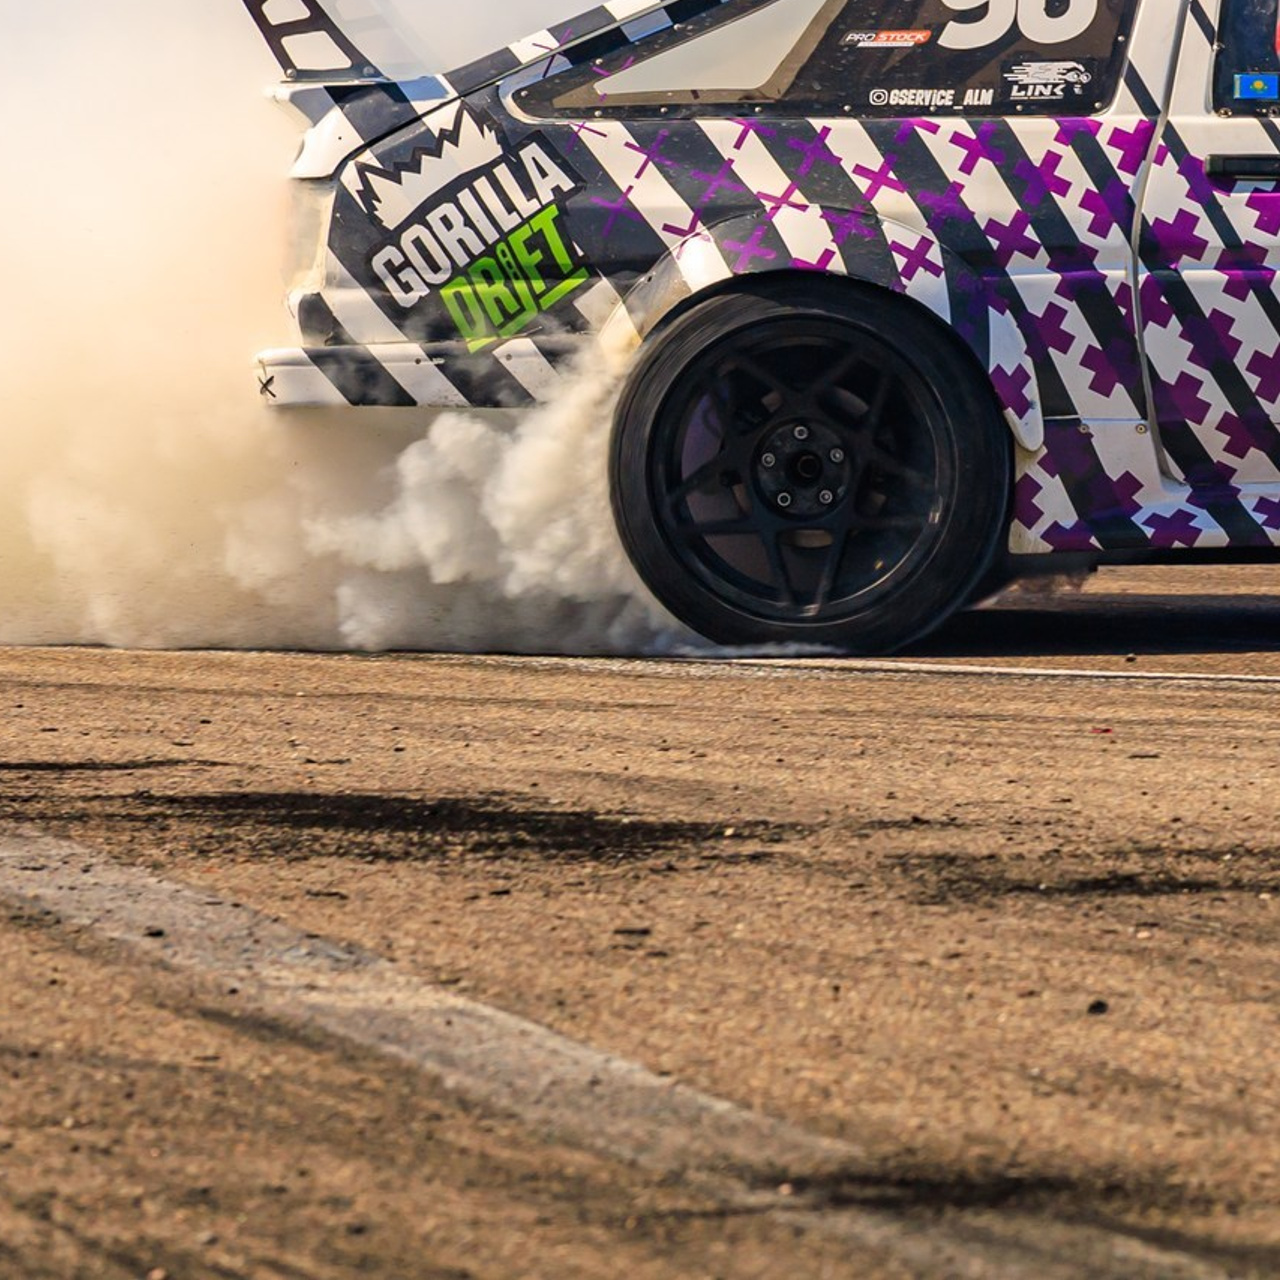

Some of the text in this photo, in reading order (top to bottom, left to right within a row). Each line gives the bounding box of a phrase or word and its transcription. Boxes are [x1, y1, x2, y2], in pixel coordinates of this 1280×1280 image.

[845, 32, 925, 42] PRO STOCK
[1010, 84, 1067, 97] LINK
[371, 141, 576, 308] GORILLA
[439, 203, 588, 354] DRIFT
